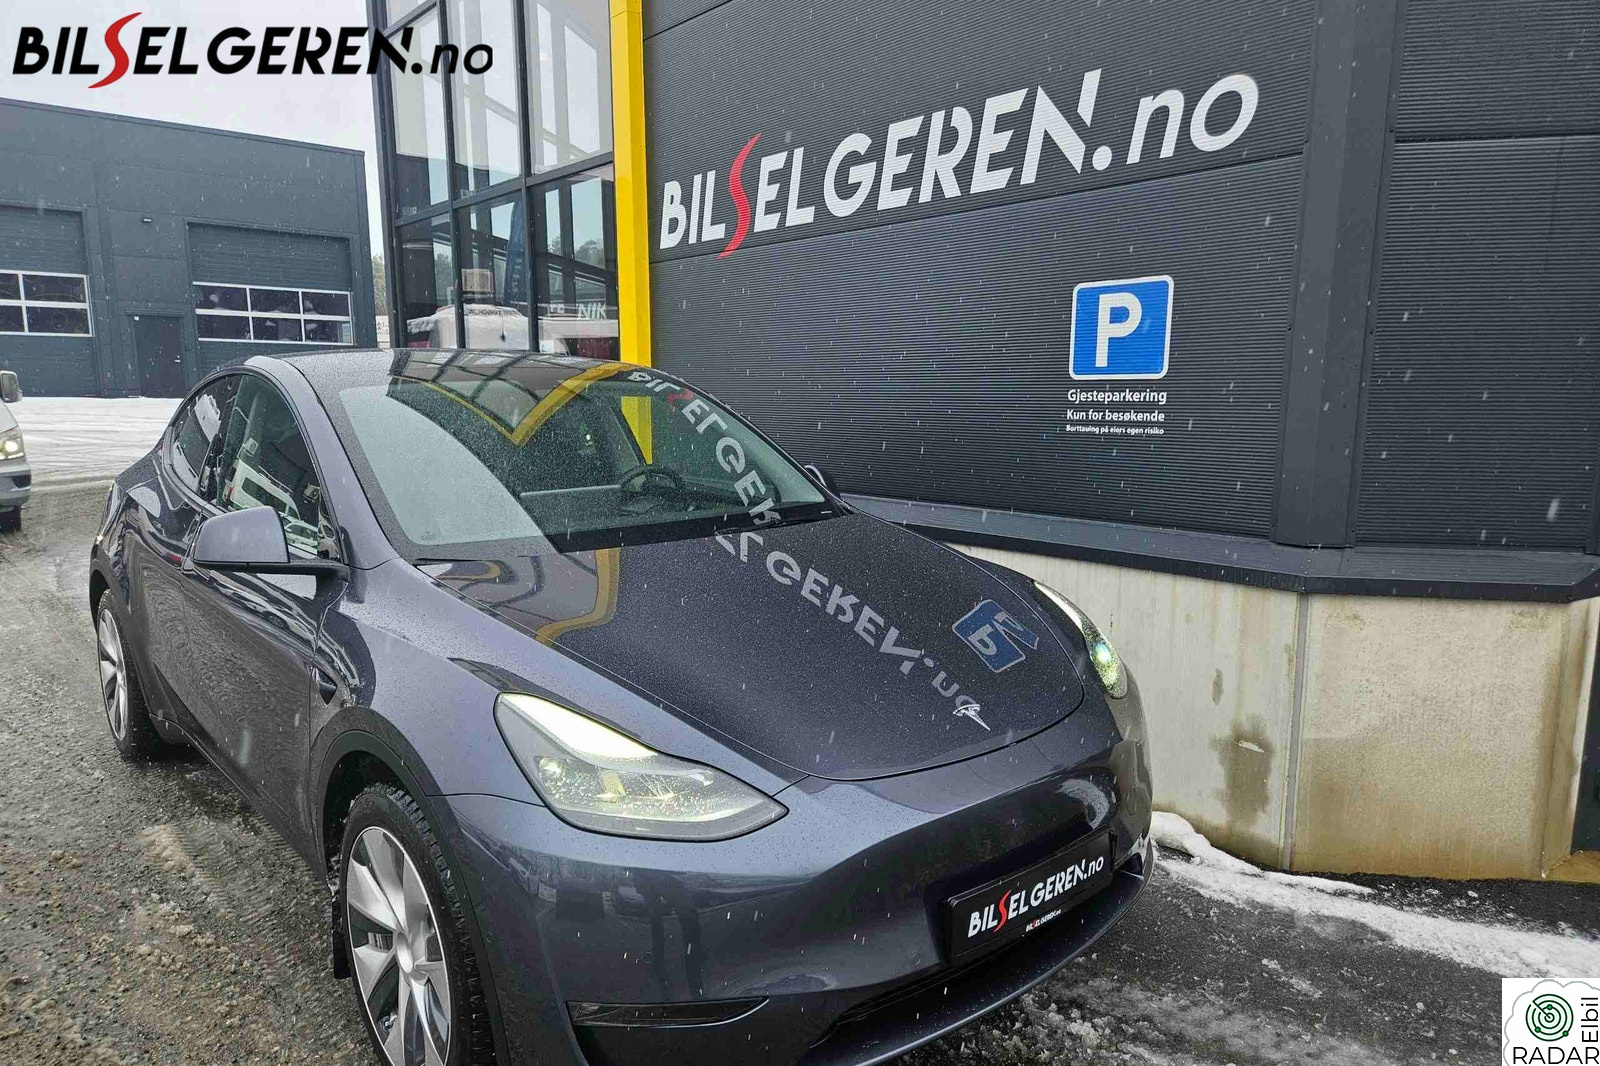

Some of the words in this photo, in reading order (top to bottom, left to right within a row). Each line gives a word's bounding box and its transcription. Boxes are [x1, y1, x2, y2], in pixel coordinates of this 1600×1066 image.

[659, 69, 1259, 259] BILSELGEREN.no
[1095, 292, 1143, 368] P
[1066, 409, 1086, 421] Kun
[1088, 409, 1103, 420] for
[1105, 409, 1165, 422] besøkende
[1067, 388, 1167, 405] Gjesteparkering
[1100, 425, 1109, 434] på
[1127, 427, 1143, 436] egen
[1144, 426, 1165, 435] risiko
[967, 855, 1105, 939] BILSELGEREN.no
